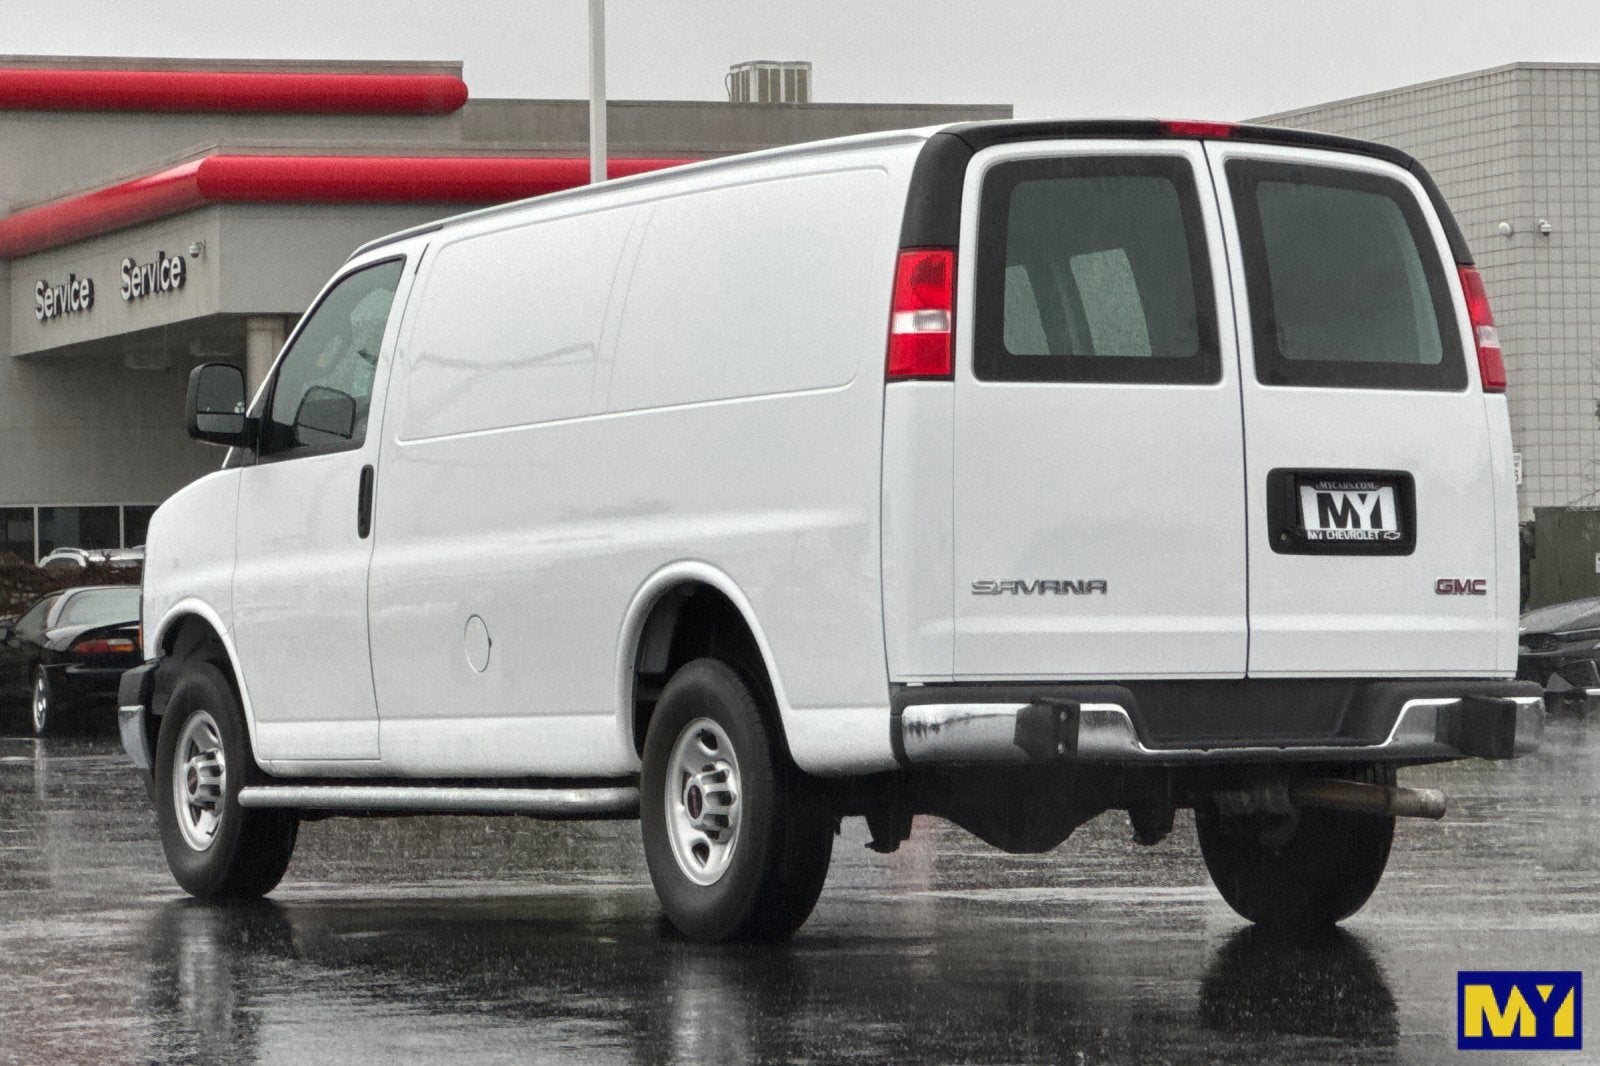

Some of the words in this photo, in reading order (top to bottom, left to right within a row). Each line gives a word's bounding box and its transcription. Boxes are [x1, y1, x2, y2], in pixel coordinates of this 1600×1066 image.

[120, 252, 185, 300] Service
[35, 275, 93, 320] Service
[1316, 492, 1383, 530] MY
[1307, 530, 1323, 540] MY
[1326, 530, 1379, 540] CHEVROLET
[971, 579, 1108, 596] SAVANA
[1435, 578, 1487, 595] GMC
